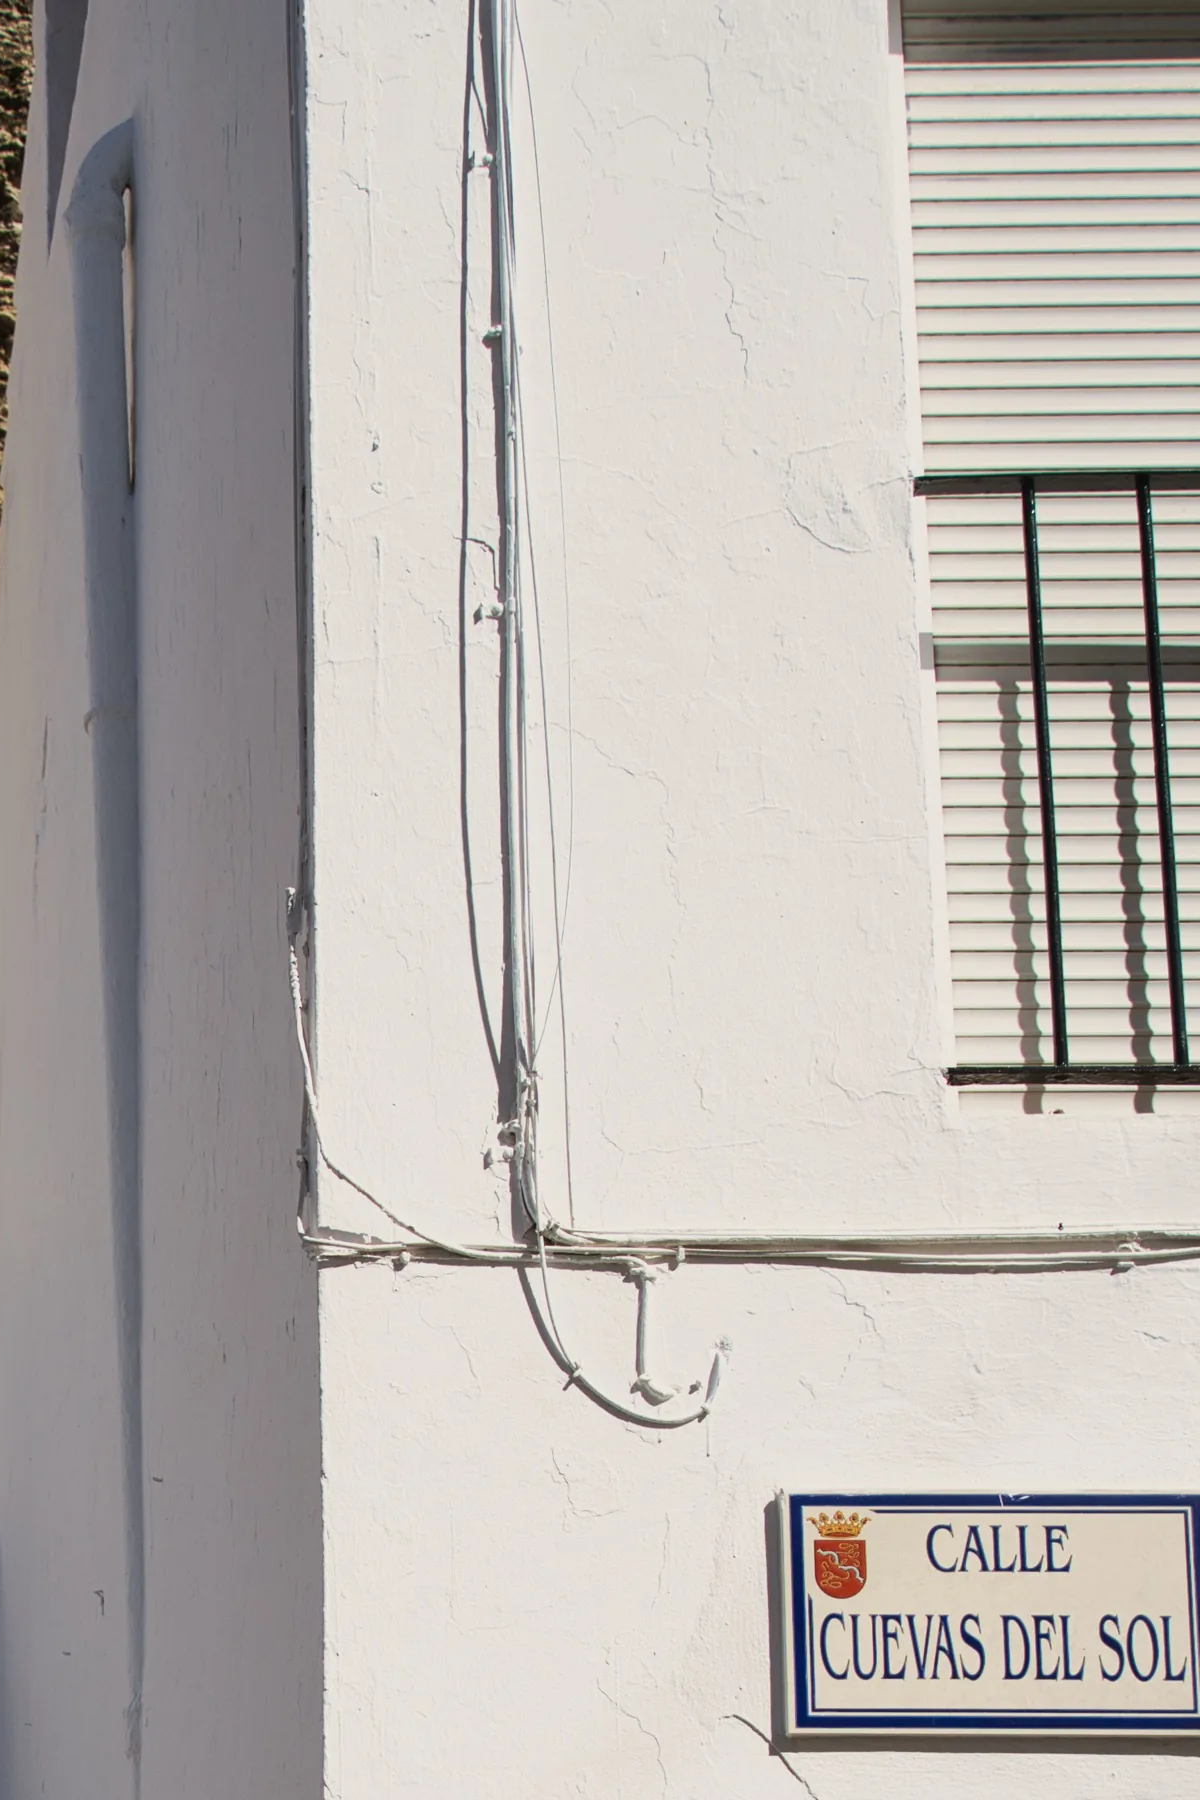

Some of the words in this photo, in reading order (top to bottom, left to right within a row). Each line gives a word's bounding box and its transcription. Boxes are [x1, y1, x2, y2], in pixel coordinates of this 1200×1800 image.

[925, 1523, 1074, 1573] CALLE
[819, 1612, 987, 1681] CUEVAS
[1000, 1613, 1087, 1682] DEL
[1098, 1613, 1188, 1682] SOL
